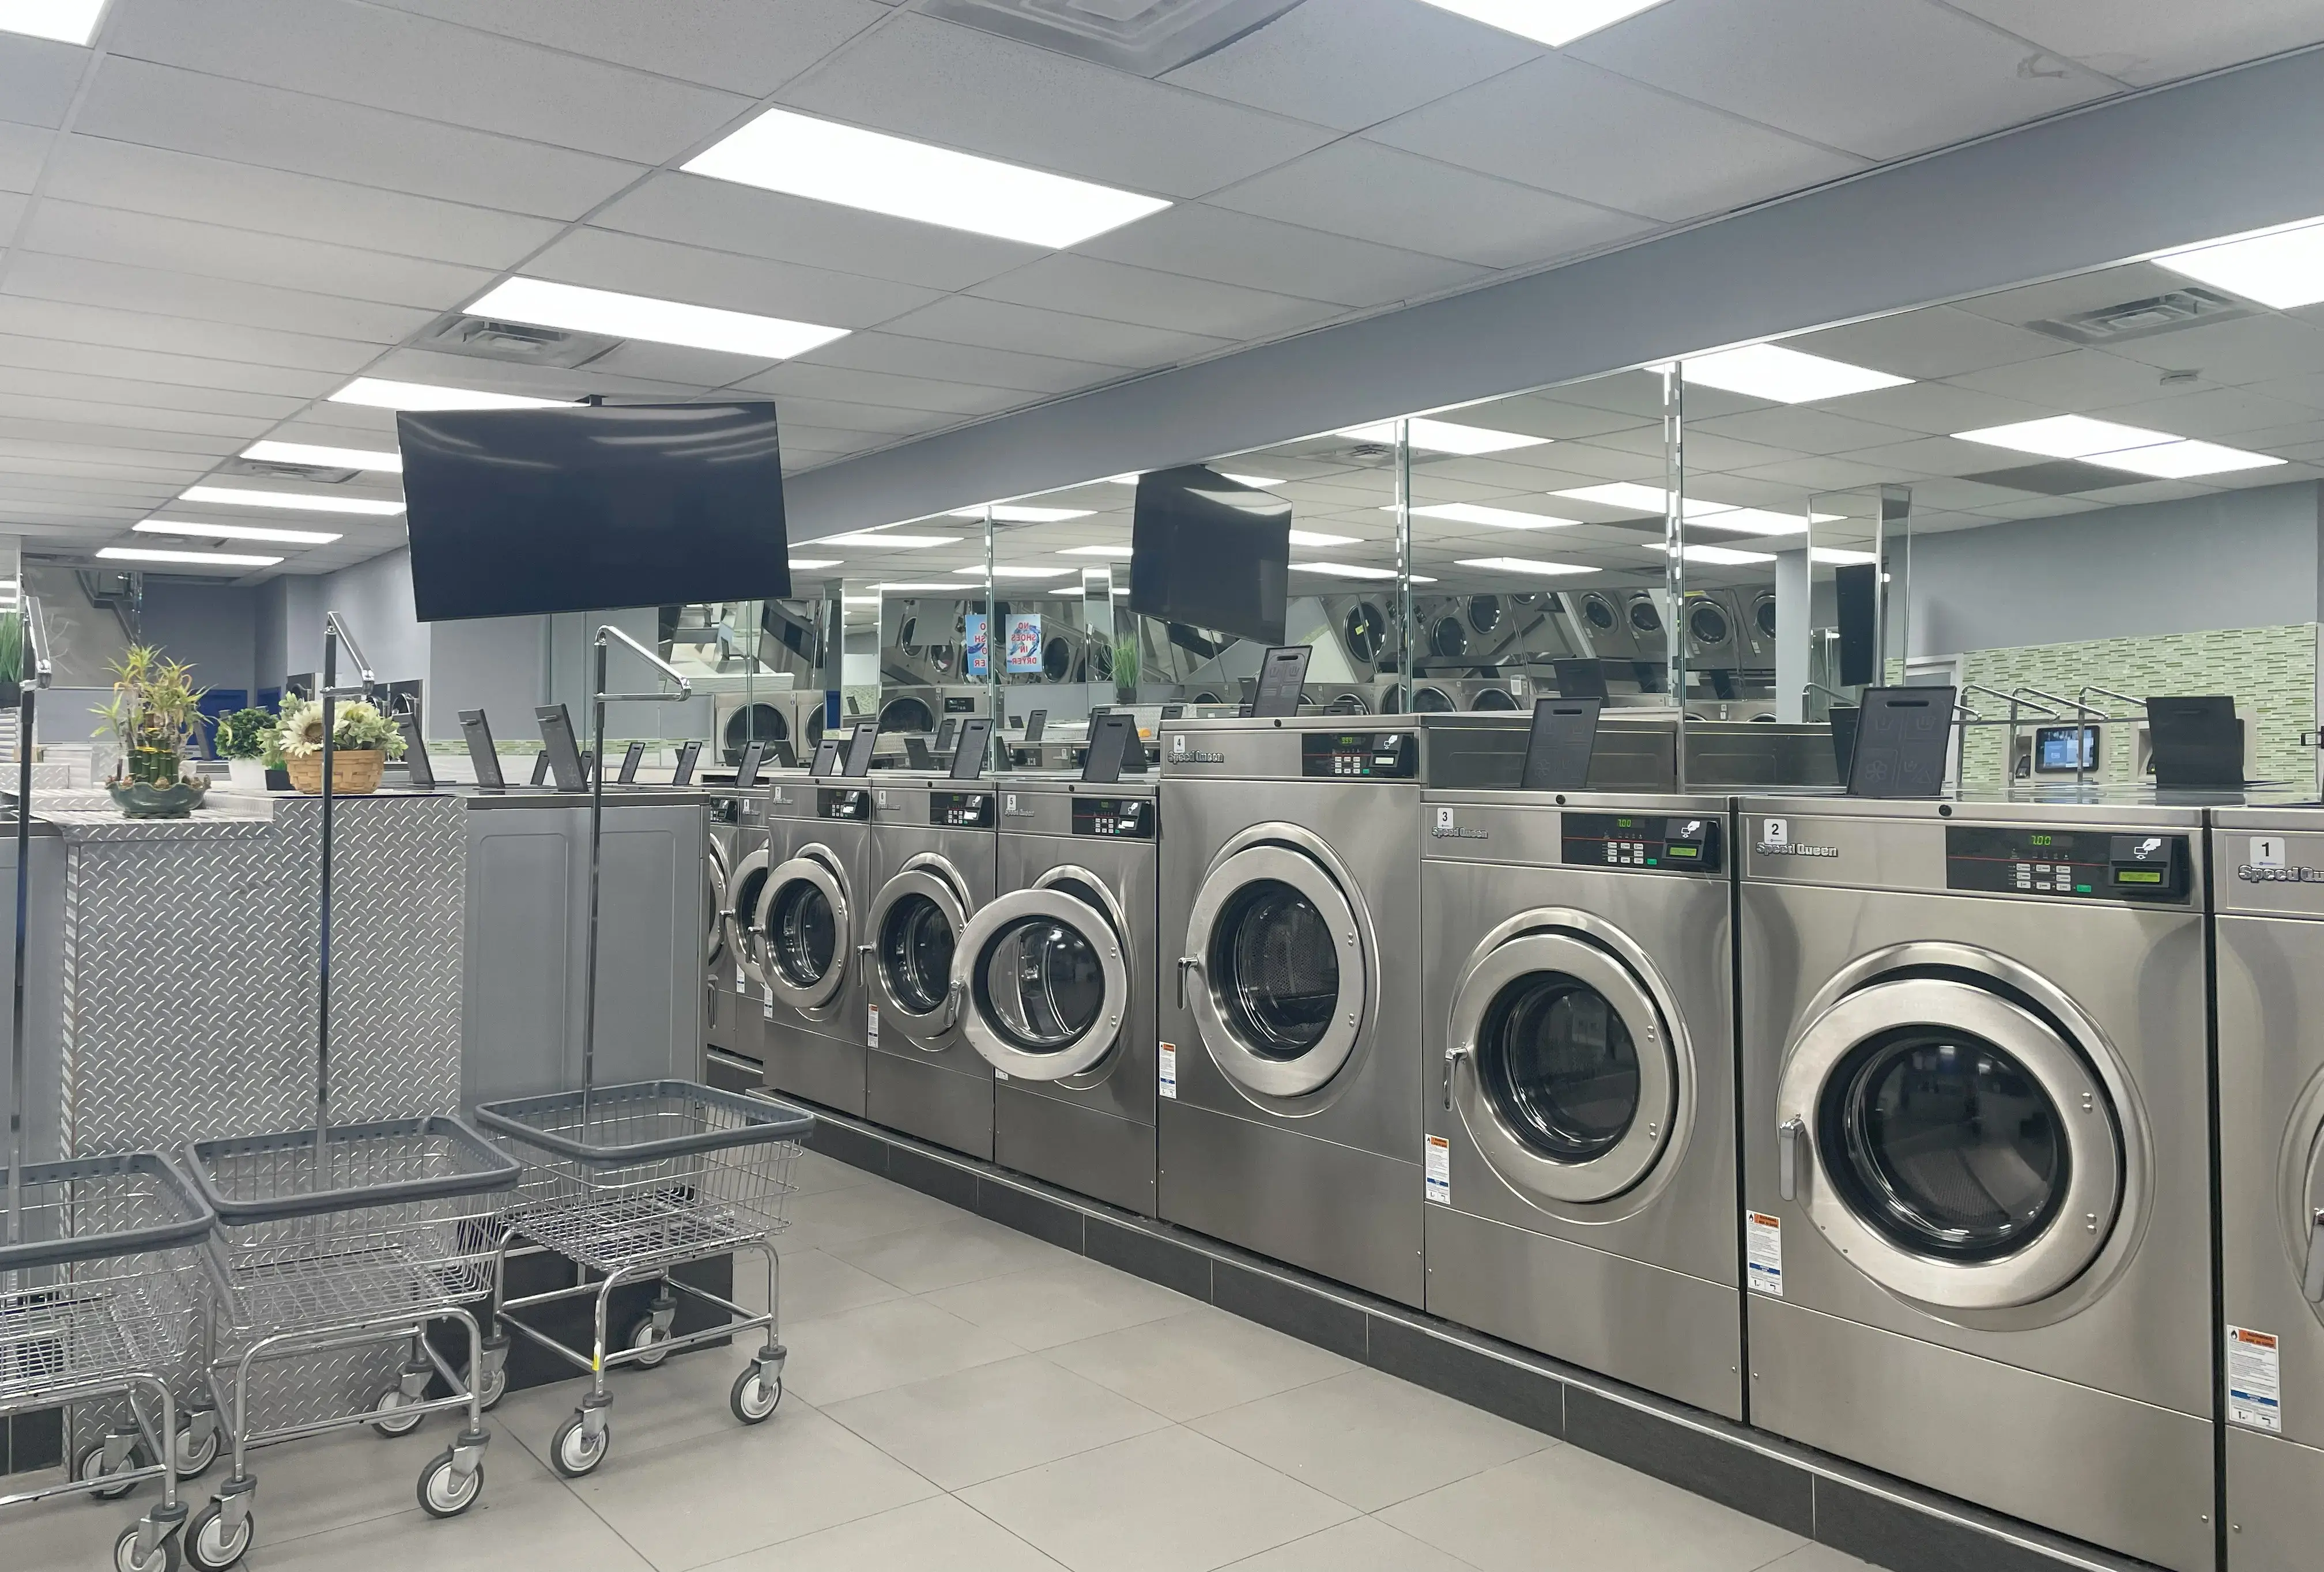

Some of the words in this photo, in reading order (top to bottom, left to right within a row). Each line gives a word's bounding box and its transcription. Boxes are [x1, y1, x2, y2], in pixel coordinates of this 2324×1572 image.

[1177, 738, 1181, 747] 4
[1168, 750, 1195, 765] Speed
[1195, 750, 1224, 763] Queen
[1009, 797, 1013, 805] 5
[1442, 811, 1448, 822] 3
[1432, 826, 1459, 838] Speed
[1459, 827, 1488, 839] Queen
[1771, 823, 1779, 835] 2
[1756, 842, 1796, 856] Speed
[1796, 842, 1838, 857] Queen
[2261, 842, 2269, 857] 1
[2238, 864, 2300, 883] Speed
